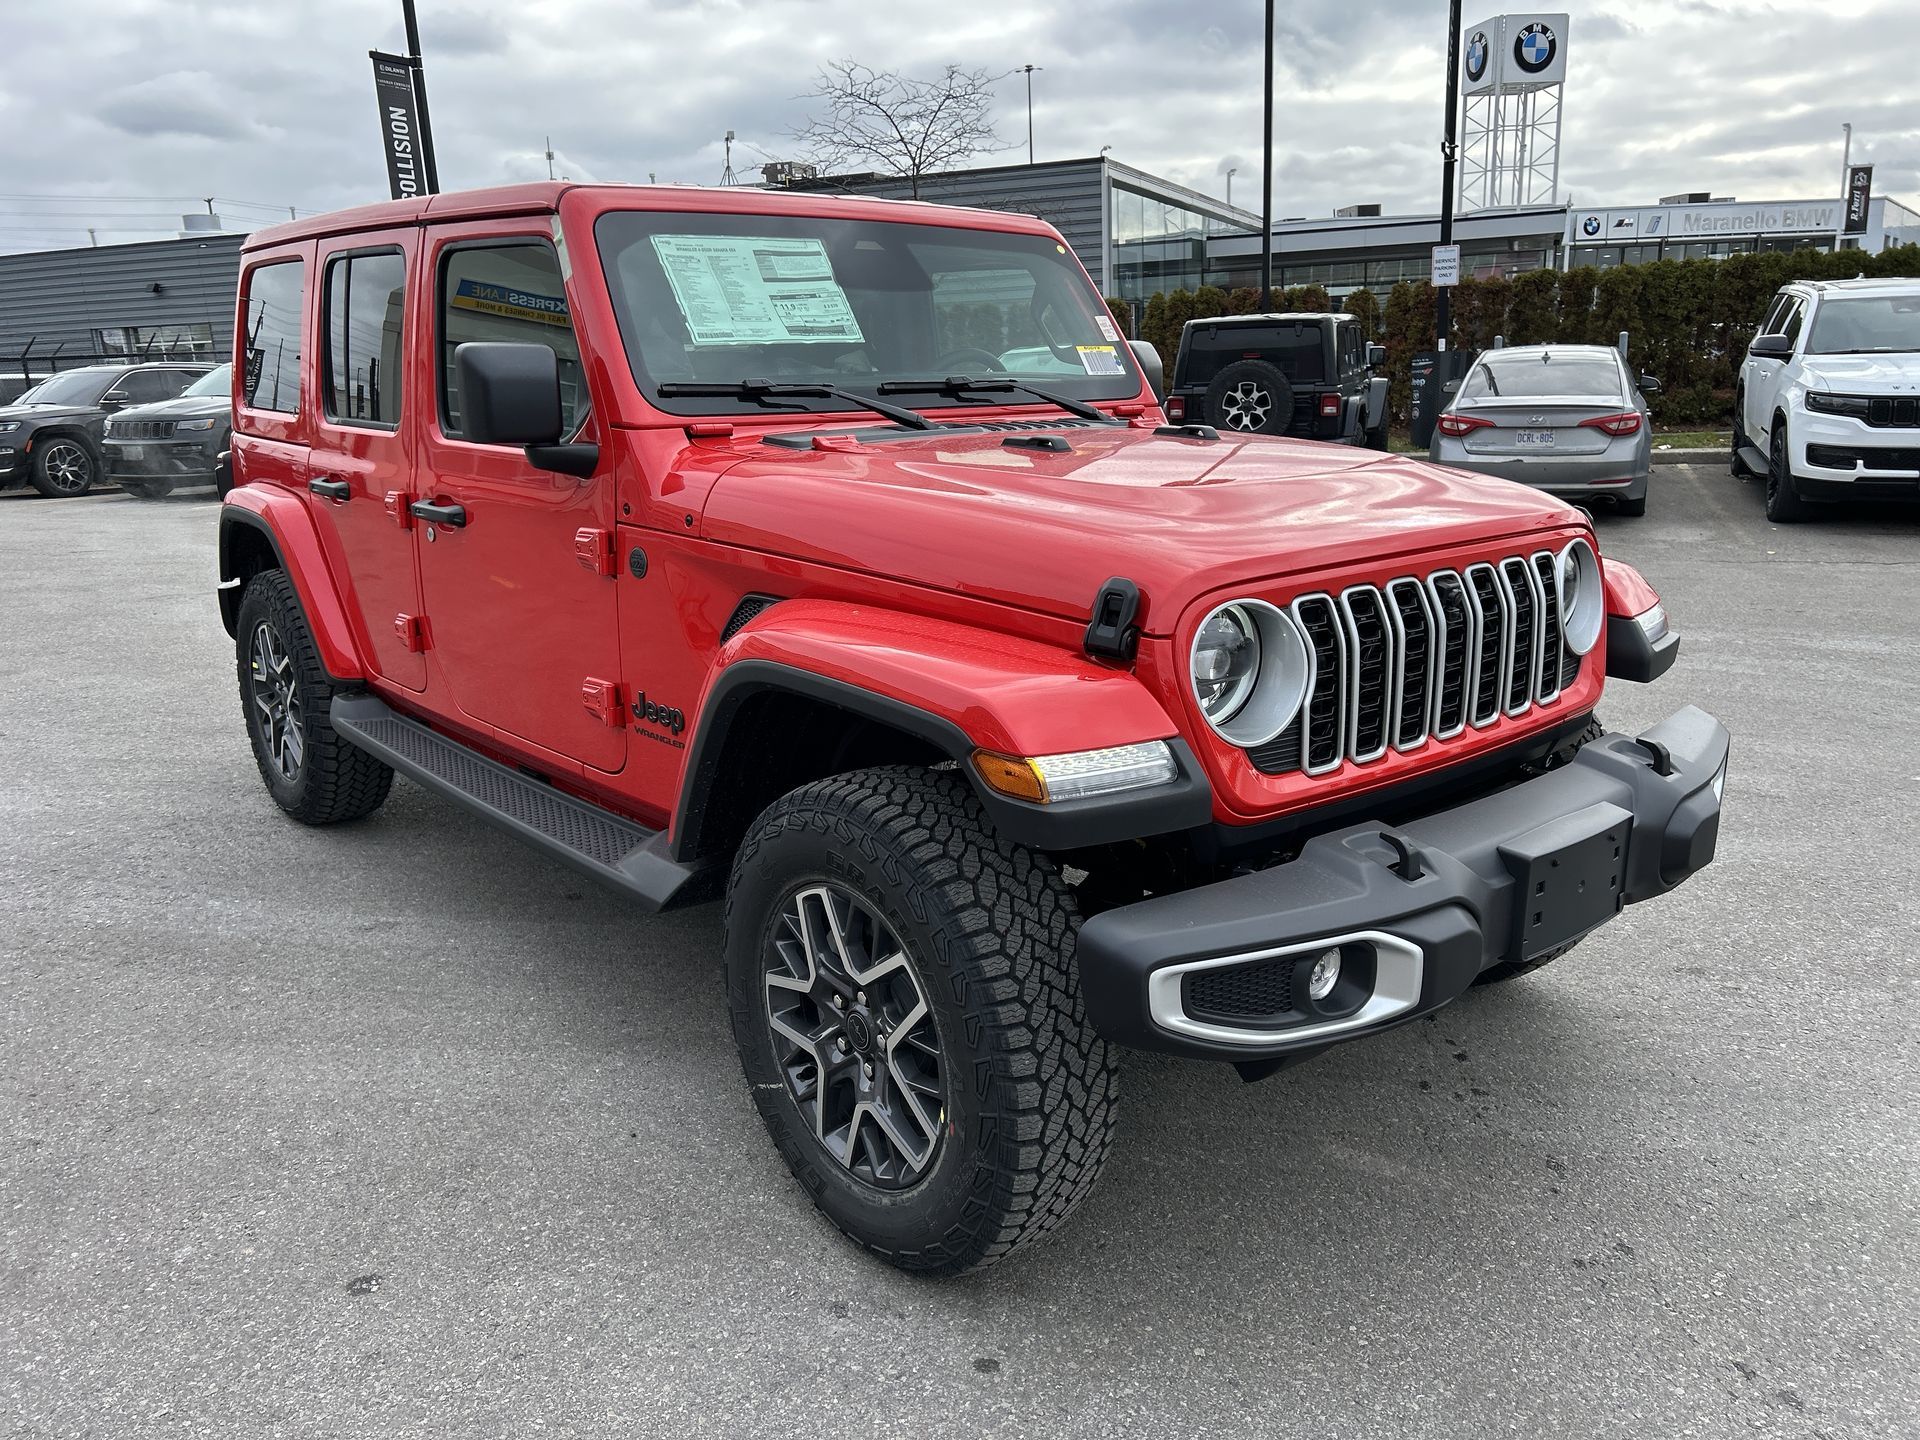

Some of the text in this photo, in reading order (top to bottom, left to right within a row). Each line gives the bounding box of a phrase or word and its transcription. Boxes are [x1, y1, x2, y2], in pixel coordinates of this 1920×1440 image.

[1519, 24, 1555, 40] BMW
[1682, 208, 1833, 232] Maranello BMW
[631, 690, 685, 736] Jeep
[634, 725, 686, 750] WRANGLER
